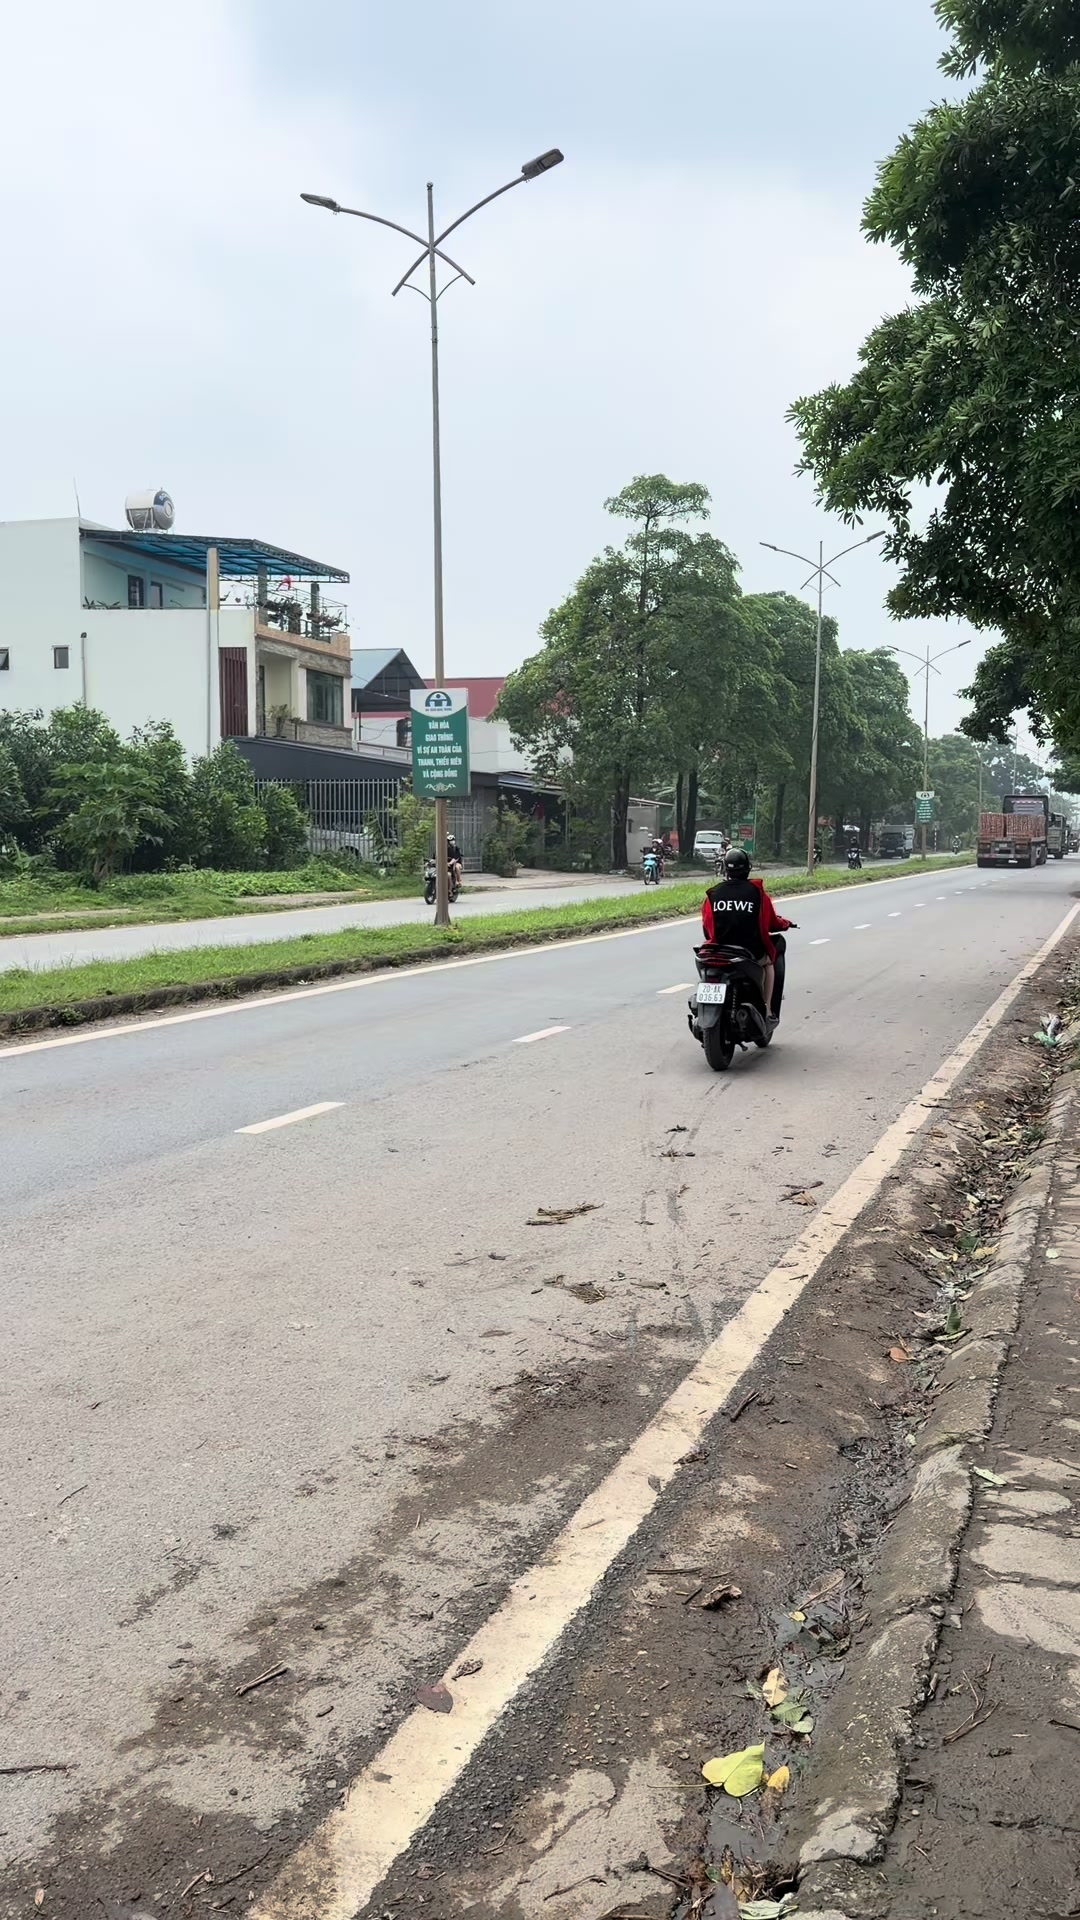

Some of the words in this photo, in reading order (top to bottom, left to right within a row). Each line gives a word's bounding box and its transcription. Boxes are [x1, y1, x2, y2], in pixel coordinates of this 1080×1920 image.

[425, 733, 436, 741] GIAO
[437, 732, 453, 741] THÔNG
[438, 744, 451, 753] TOÀN
[452, 743, 462, 753] CỦA
[423, 769, 429, 778] VÀ
[713, 900, 754, 913] LOEWE
